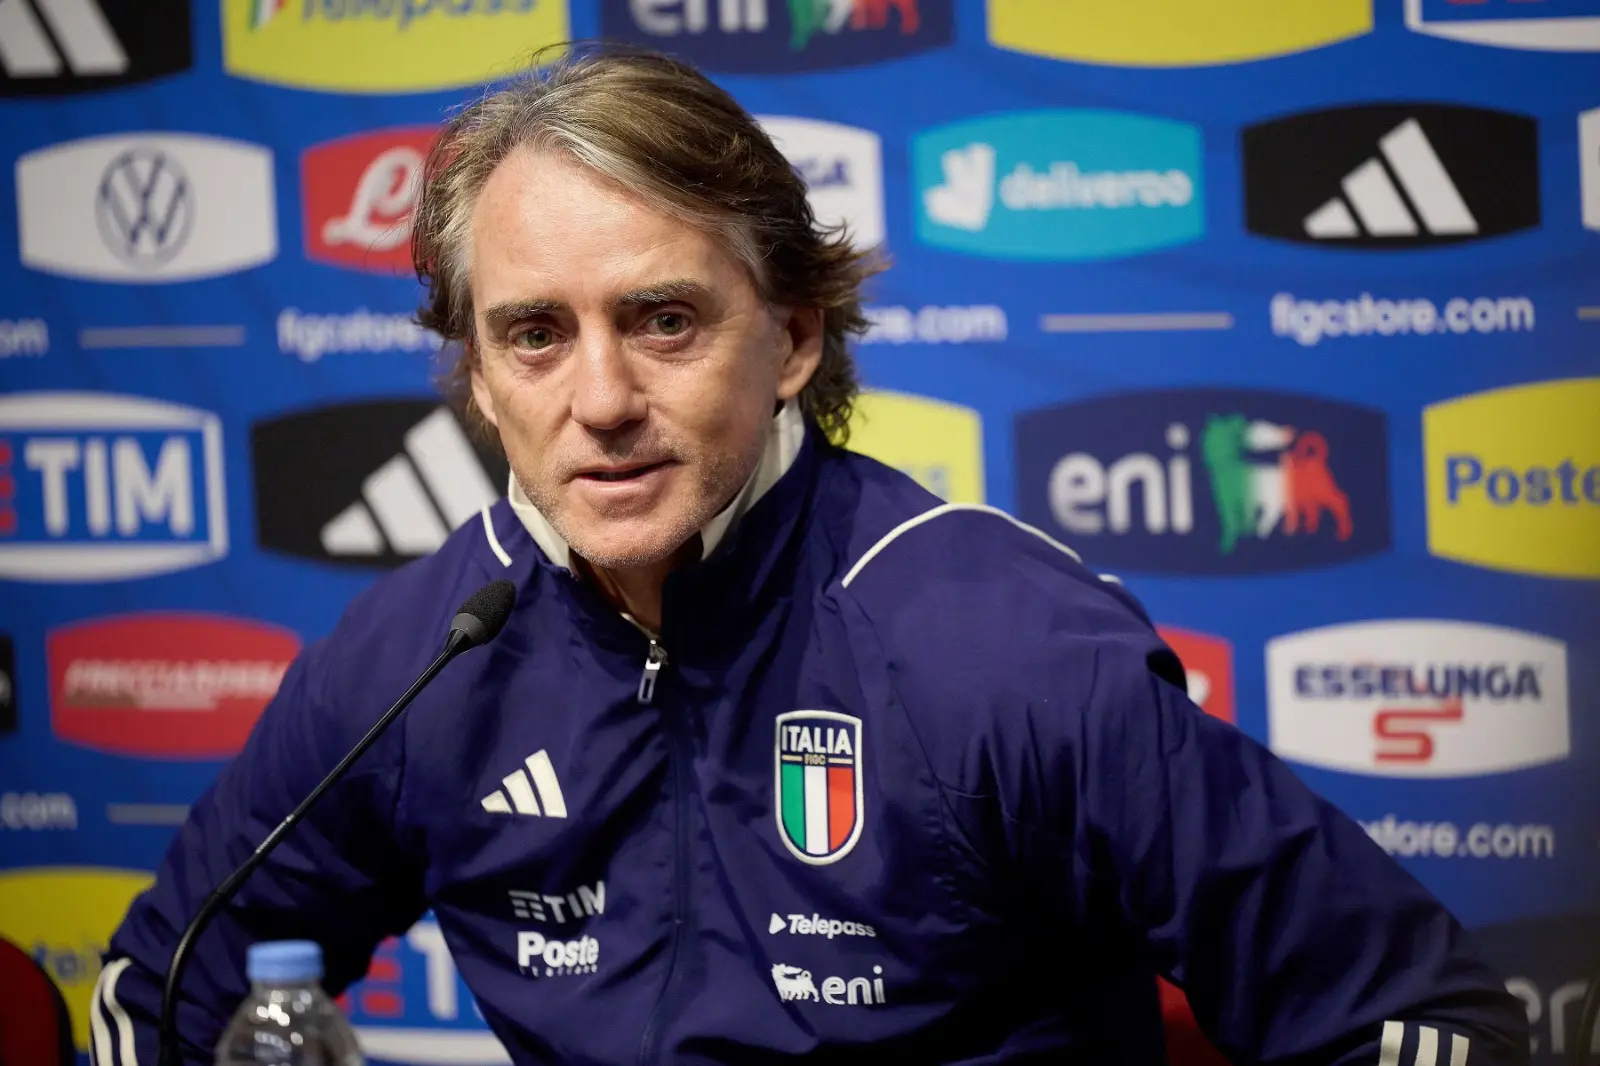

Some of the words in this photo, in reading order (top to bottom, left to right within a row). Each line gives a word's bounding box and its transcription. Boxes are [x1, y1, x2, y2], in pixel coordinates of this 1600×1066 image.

[1270, 293, 1535, 345] figcstore.com
[25, 438, 194, 536] TIM
[1049, 423, 1194, 533] eni
[1294, 663, 1543, 699] ESSELUNGA
[782, 725, 853, 755] ITALIA
[804, 753, 826, 765] FIGC
[542, 880, 605, 924] TIM
[787, 913, 876, 939] Telepass
[517, 930, 600, 967] Poste
[821, 965, 886, 1005] eni
